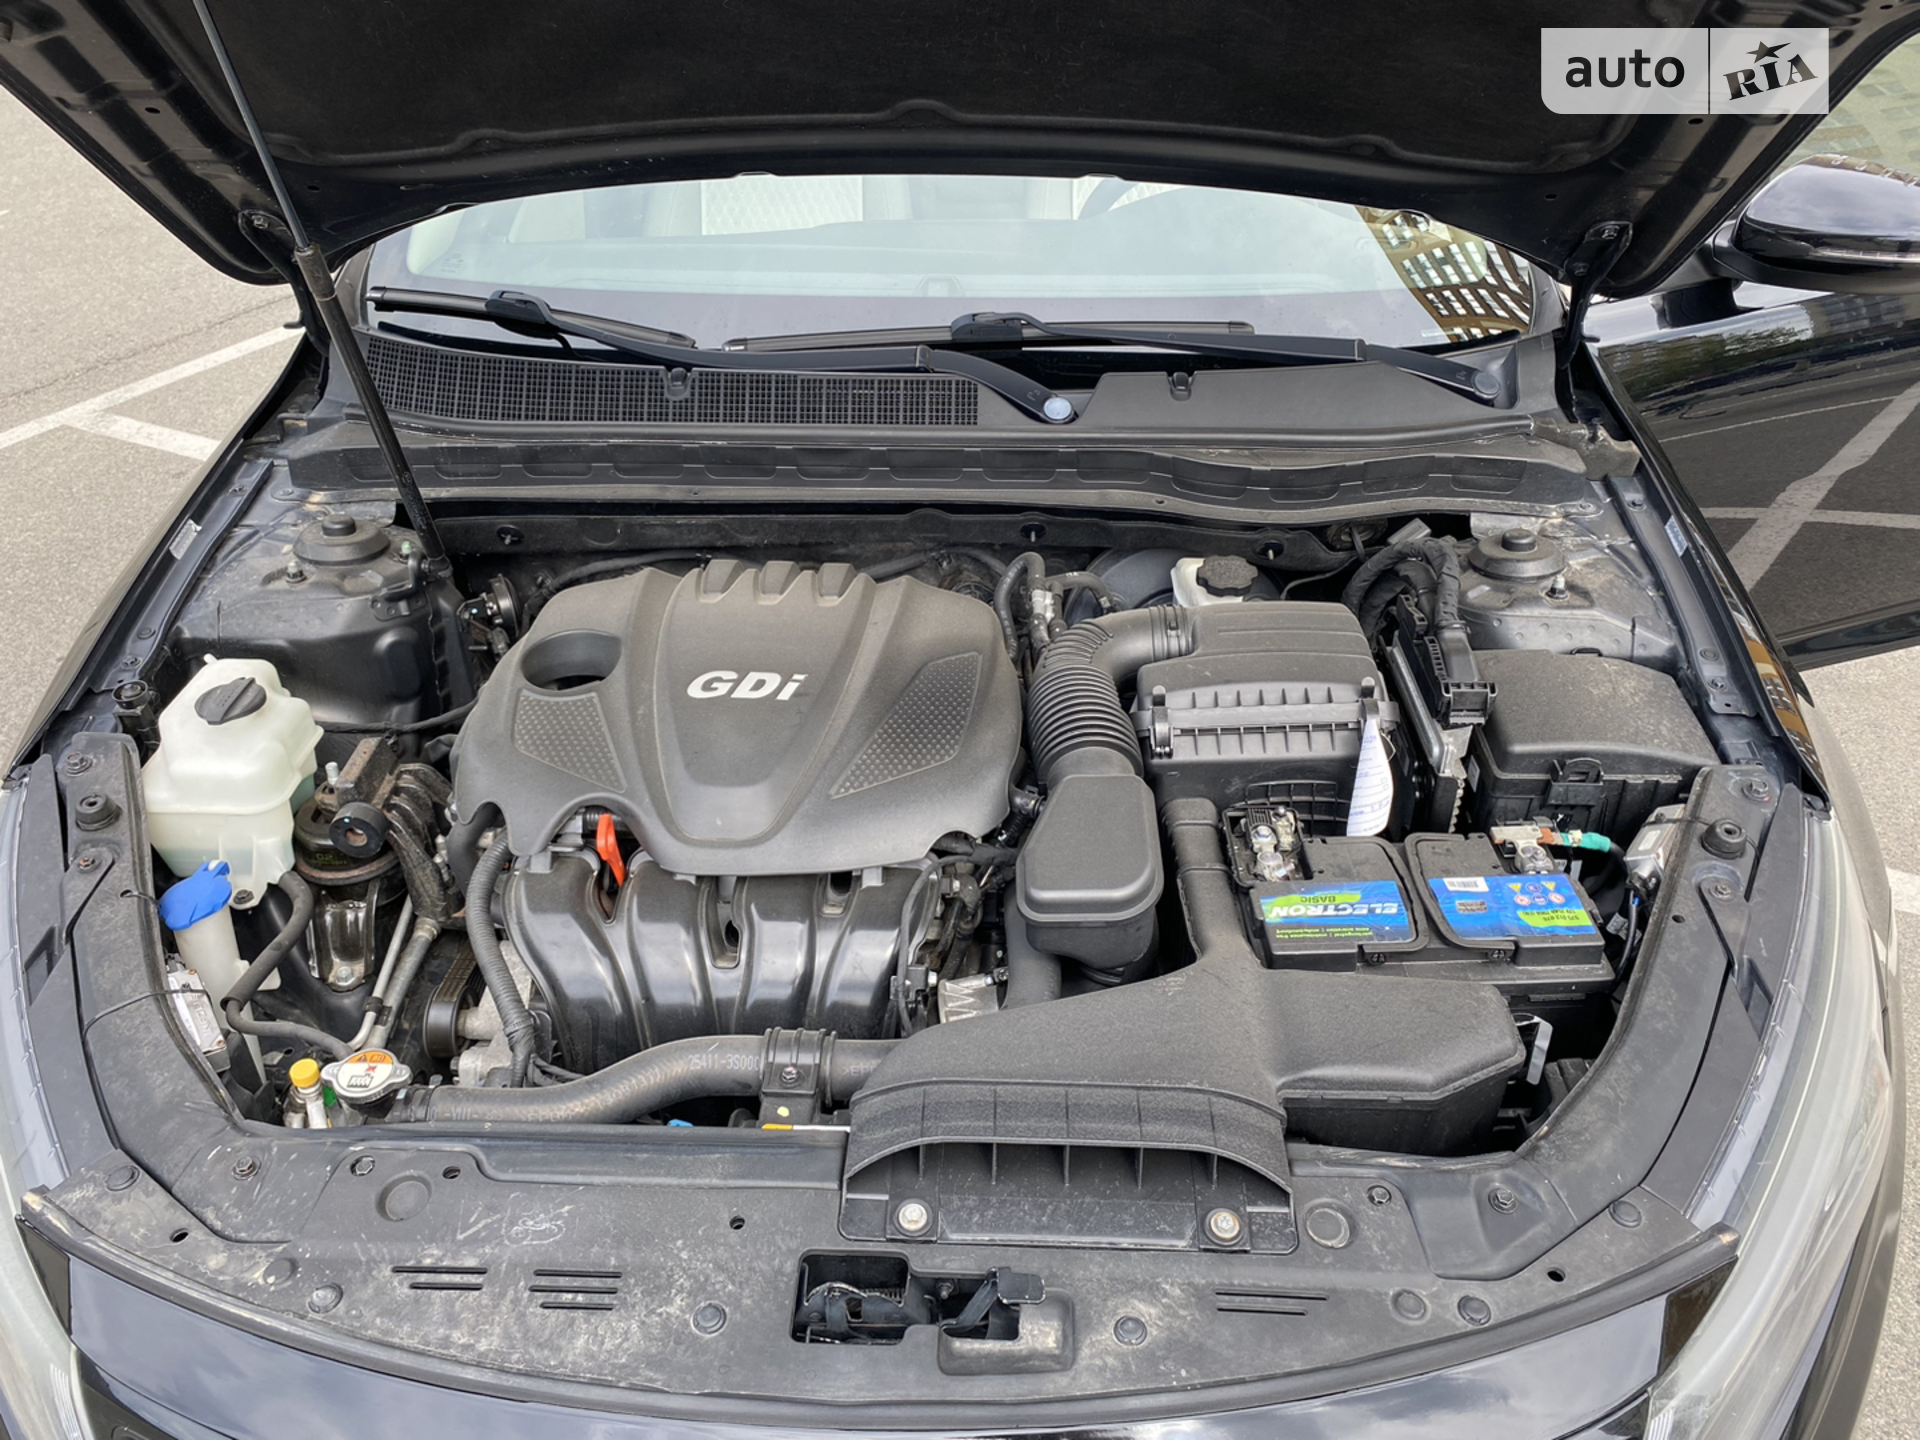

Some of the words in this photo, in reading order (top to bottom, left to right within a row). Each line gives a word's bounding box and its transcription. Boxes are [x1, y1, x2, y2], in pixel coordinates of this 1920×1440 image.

[686, 670, 809, 701] GDi
[1299, 895, 1337, 903] BASIC
[1268, 902, 1399, 918] ELECTRON
